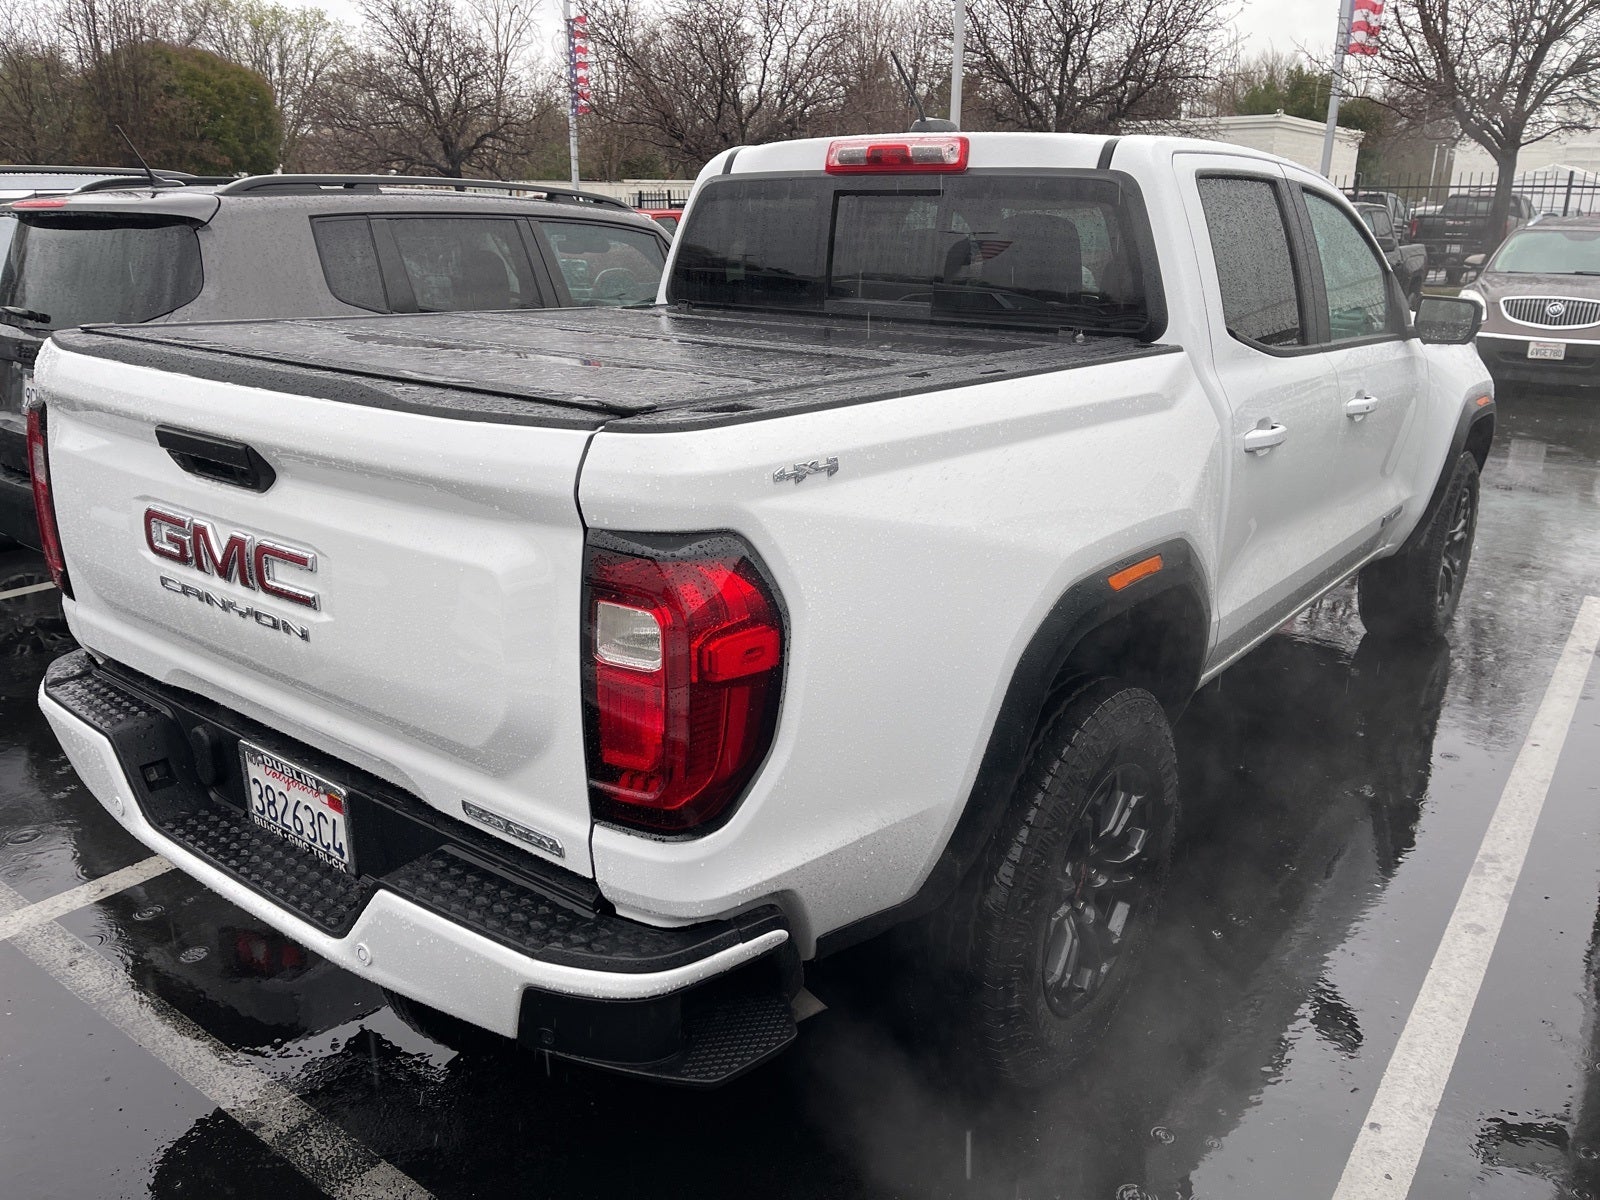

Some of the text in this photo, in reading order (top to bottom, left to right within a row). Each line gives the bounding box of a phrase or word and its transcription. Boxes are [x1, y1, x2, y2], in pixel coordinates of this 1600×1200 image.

[144, 504, 320, 611] GMC
[160, 575, 310, 642] CANYON
[263, 755, 318, 791] DUBLIN
[252, 778, 345, 859] 38263C4
[254, 815, 347, 874] BUICK GMC TRUCK
